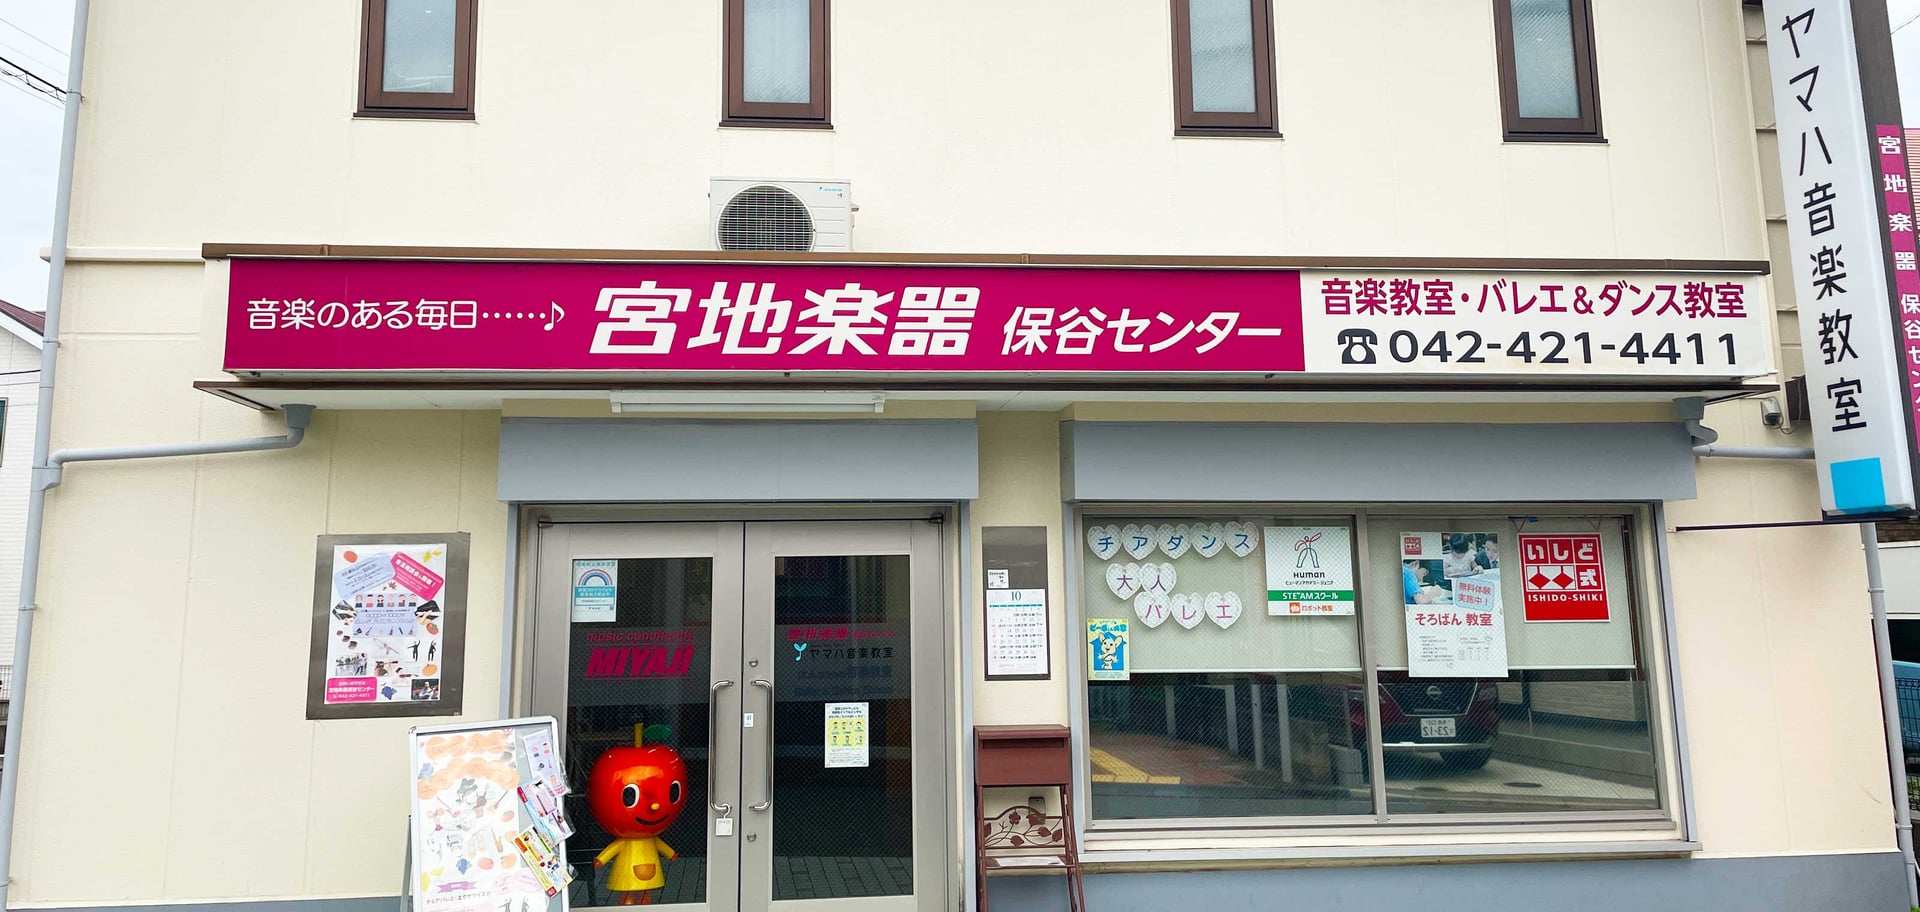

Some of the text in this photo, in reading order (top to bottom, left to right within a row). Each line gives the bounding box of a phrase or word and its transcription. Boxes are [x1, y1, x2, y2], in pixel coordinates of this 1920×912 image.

[1878, 136, 1916, 271] 宮地楽器
[1782, 8, 1867, 432] ヤマハ音楽教室
[589, 280, 1282, 356] 宮地楽器 保谷センター
[1389, 330, 1736, 365] 042-421-4411
[1097, 532, 1250, 553] チアダンス
[1527, 542, 1594, 561] いしど
[1116, 574, 1169, 593] 大人
[1293, 571, 1326, 579] Human
[1579, 568, 1598, 587] 式
[1010, 590, 1022, 601] 10
[1528, 593, 1603, 602] ISHIDO-SHIKI
[1145, 603, 1233, 621] バレエ
[1415, 612, 1494, 626] そろばん 教室
[586, 632, 624, 641] music
[585, 647, 695, 677] MIYAJI
[810, 647, 895, 659] ヤマハ音楽教室
